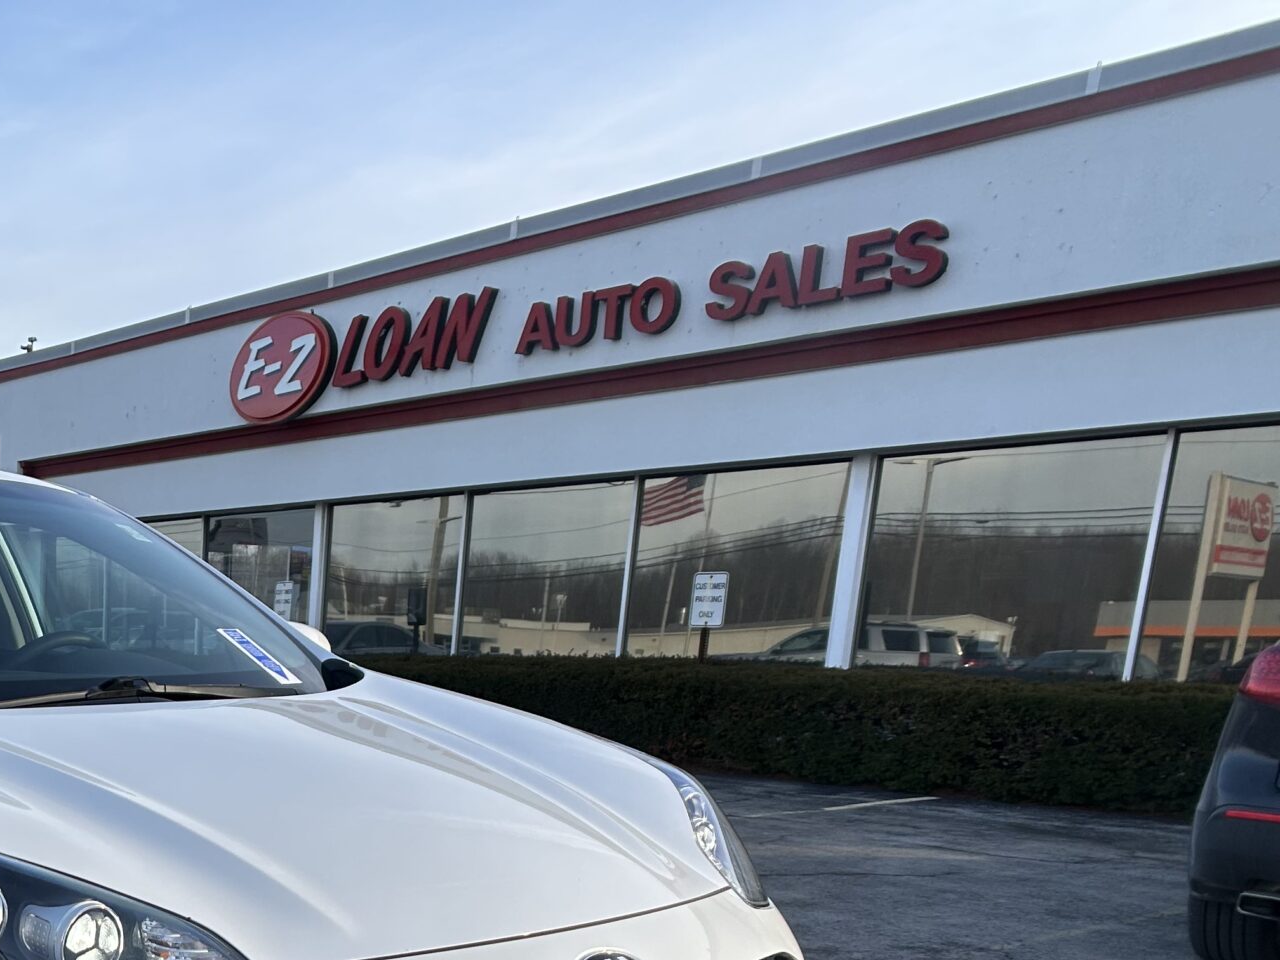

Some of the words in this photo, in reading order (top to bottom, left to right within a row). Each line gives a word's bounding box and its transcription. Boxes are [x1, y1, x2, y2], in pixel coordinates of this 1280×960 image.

[237, 333, 316, 401] E-Z
[332, 286, 500, 389] LOAN
[515, 276, 682, 355] AUTO
[705, 218, 950, 321] SALES
[698, 610, 715, 618] ONLY
